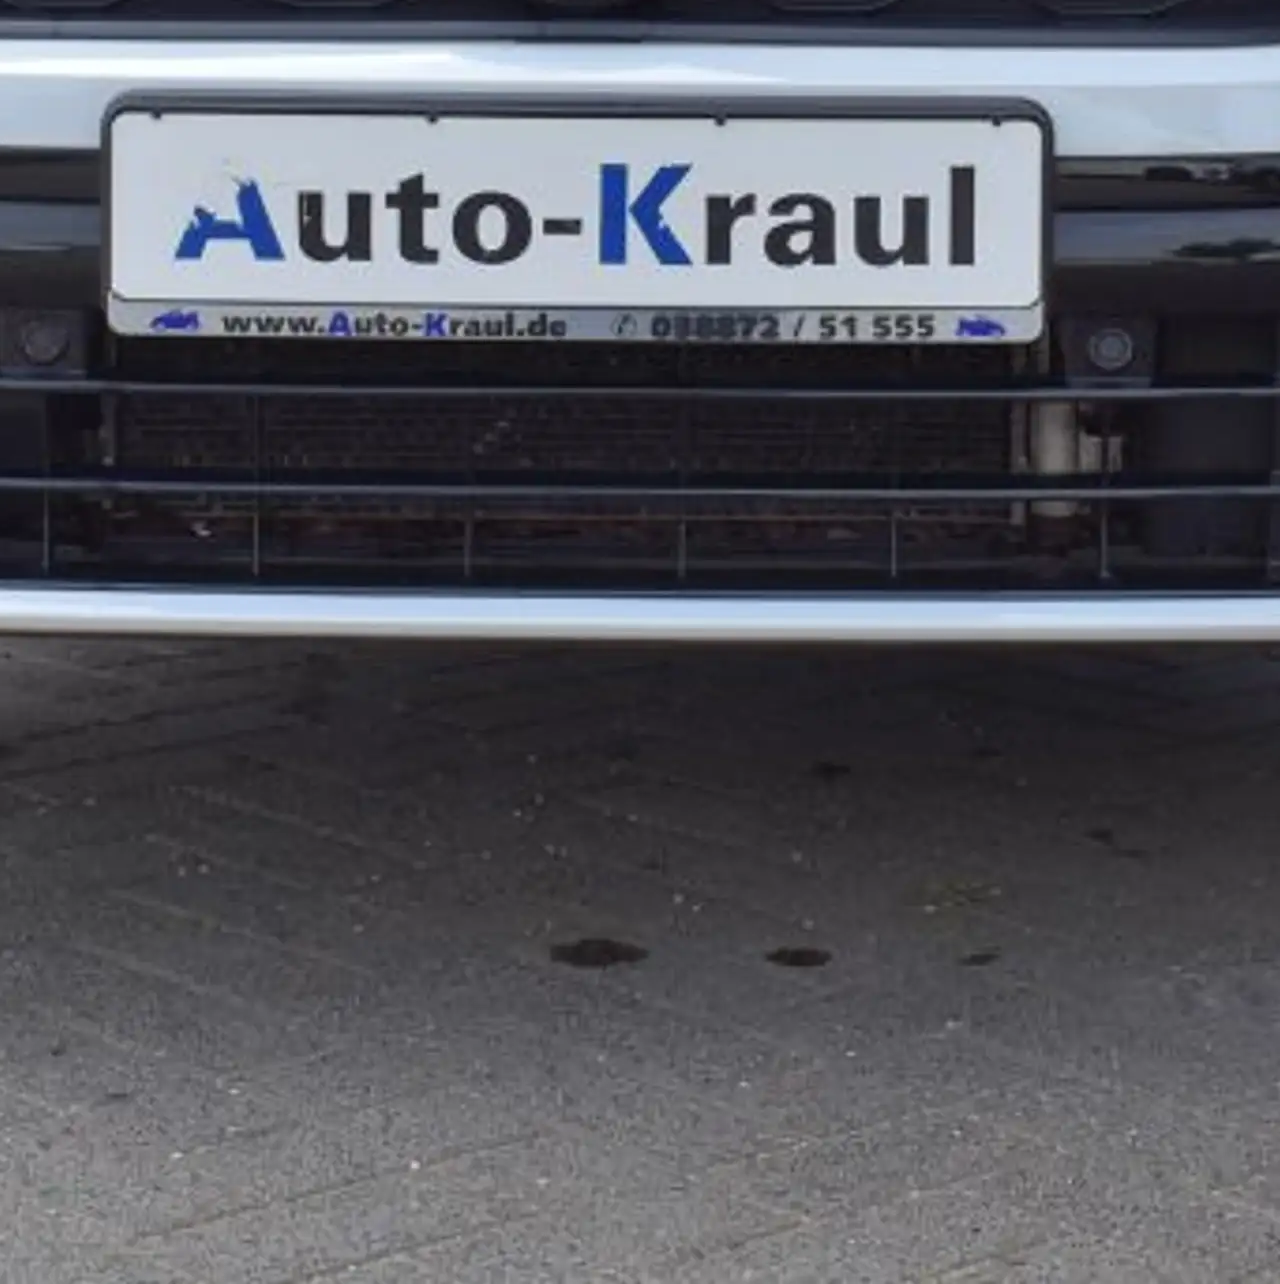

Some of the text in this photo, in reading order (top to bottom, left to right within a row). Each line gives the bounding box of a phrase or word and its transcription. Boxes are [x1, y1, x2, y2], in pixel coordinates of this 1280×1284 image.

[174, 162, 976, 266] Auto-Kraul
[222, 312, 568, 339] www.Auto-Kraul.de
[819, 315, 858, 339] 51
[871, 315, 935, 339] 555
